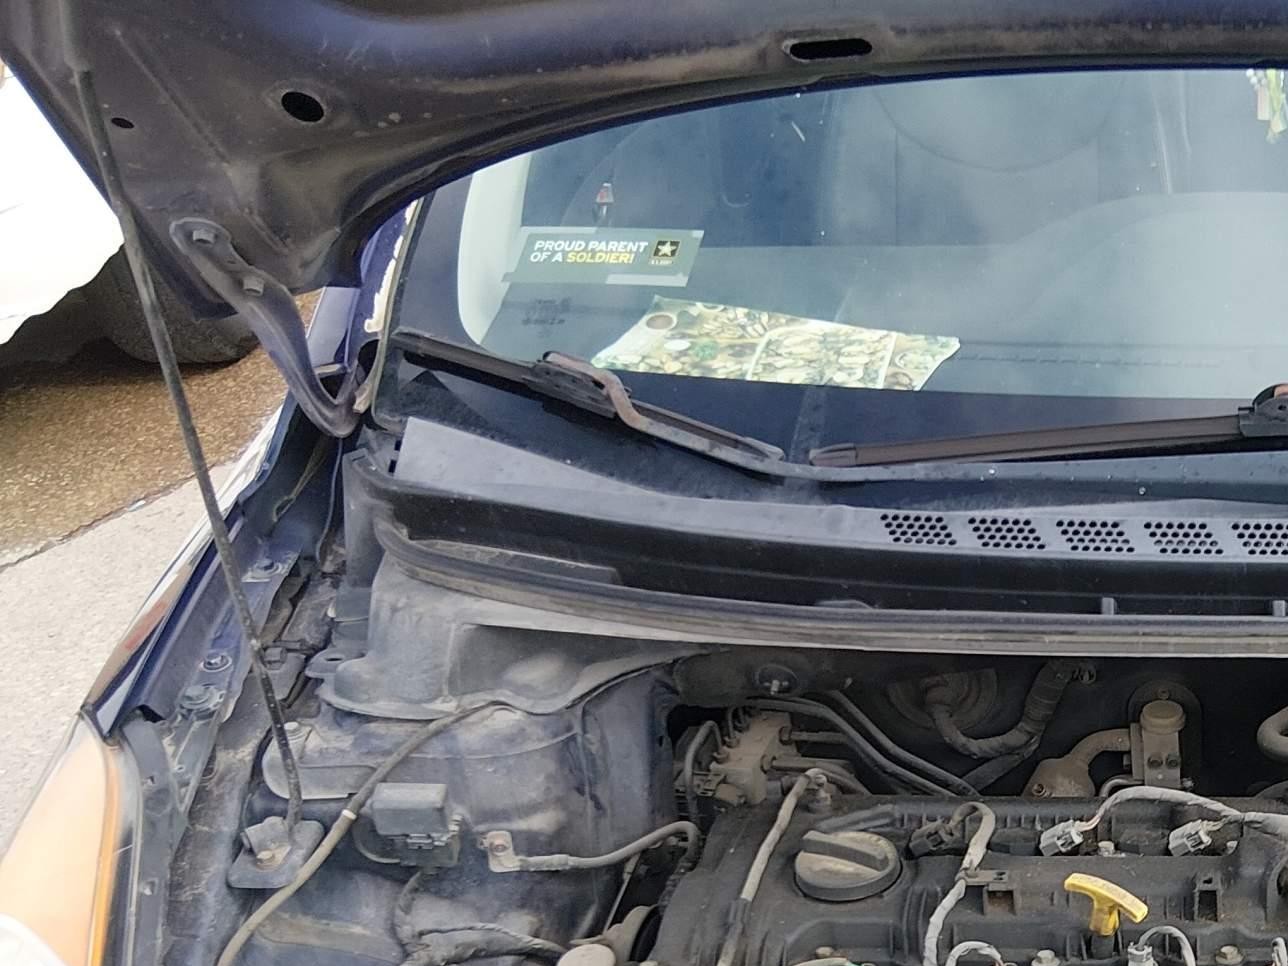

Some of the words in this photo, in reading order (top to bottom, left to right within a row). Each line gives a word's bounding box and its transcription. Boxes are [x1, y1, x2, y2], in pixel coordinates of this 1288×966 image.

[534, 240, 587, 251] PROUD
[588, 241, 648, 252] PARENT
[530, 251, 550, 262] OF
[551, 252, 563, 262] A
[566, 252, 635, 264] SOLDIER!
